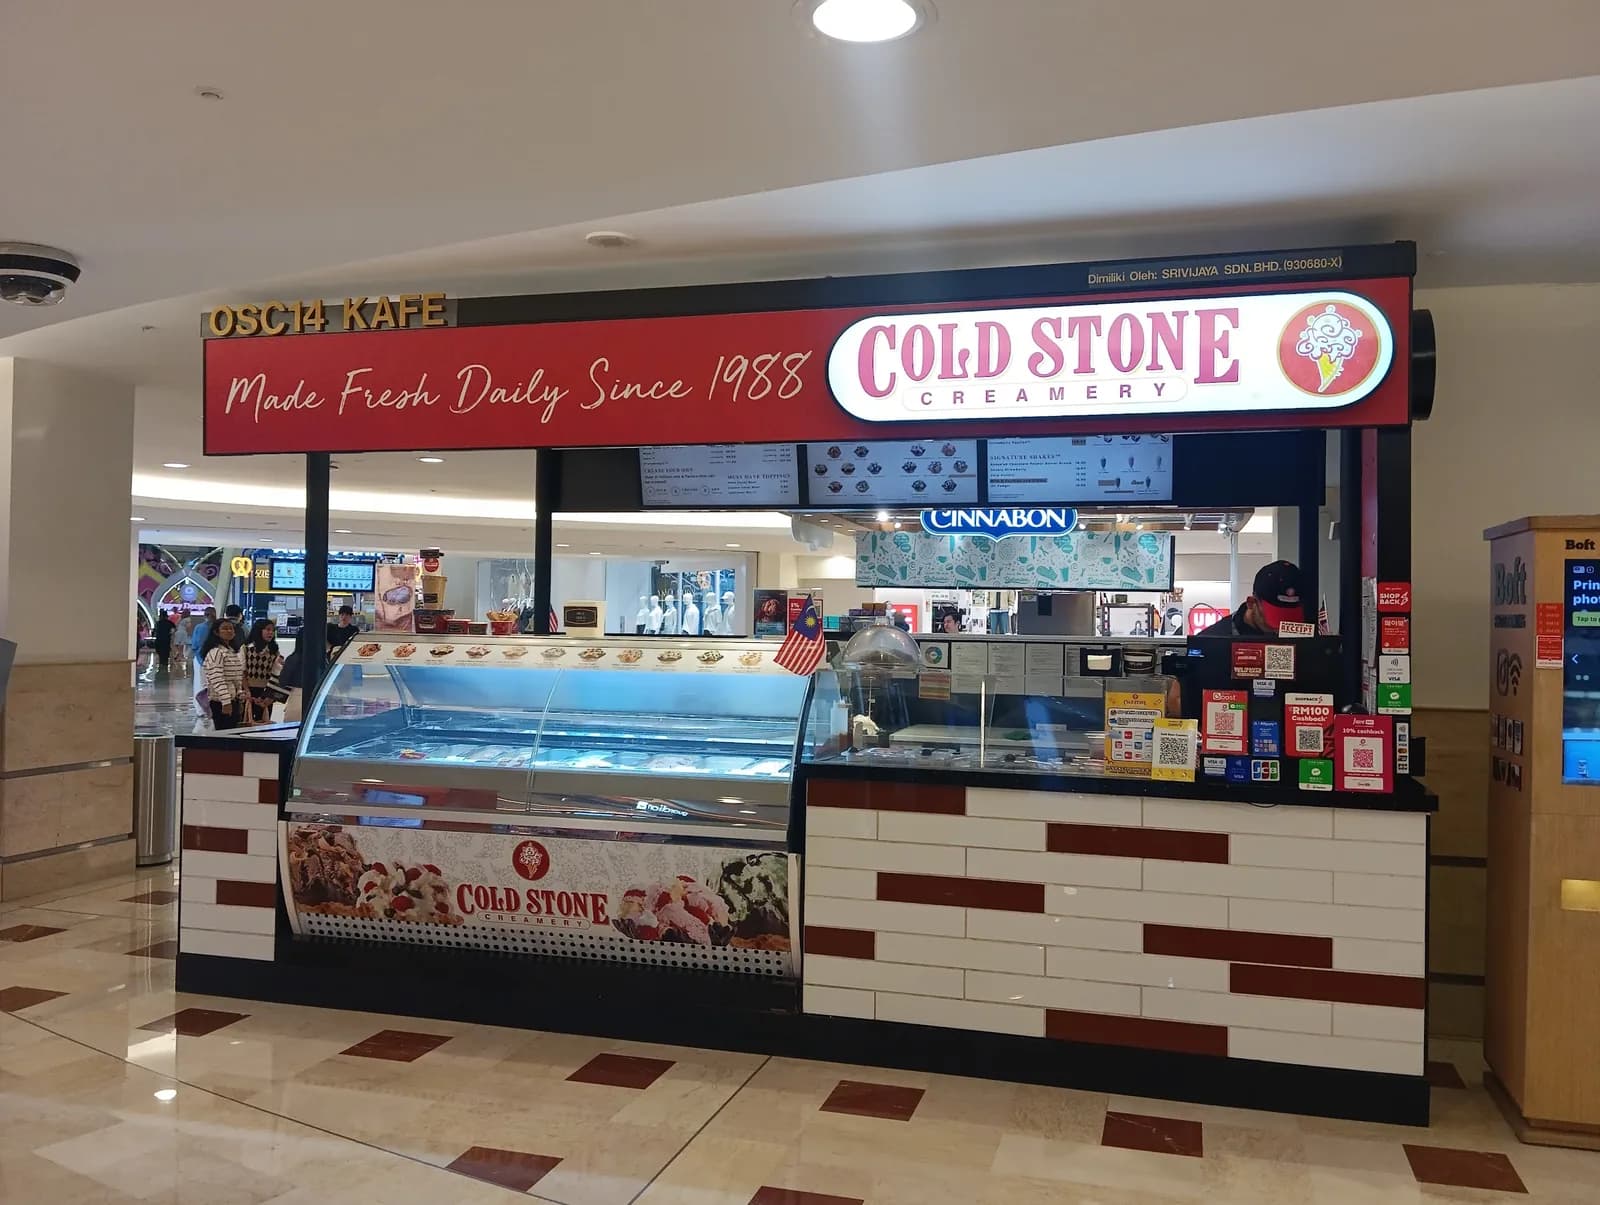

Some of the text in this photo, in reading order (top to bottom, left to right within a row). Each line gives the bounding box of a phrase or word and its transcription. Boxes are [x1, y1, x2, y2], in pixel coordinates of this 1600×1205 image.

[1088, 271, 1126, 285] Dimiliki
[1129, 269, 1158, 283] Oleh:
[1161, 265, 1219, 280] SRIVIJAYA
[1283, 255, 1343, 272] (930680-X)
[208, 293, 447, 337] OSC14 KAFE
[857, 307, 1240, 399] COLD STONE
[225, 350, 813, 424] Made Fresh Daily Since 1988
[920, 382, 1167, 406] CREAMERY
[930, 508, 1068, 529] CINNABON
[1564, 538, 1596, 551] Boft
[1493, 556, 1526, 605] Boft
[1573, 594, 1600, 606] pho
[1281, 625, 1312, 633] RECEIPT
[1292, 706, 1330, 716] RM100
[456, 884, 610, 925] COLD STONE
[485, 914, 582, 927] CREAMERY
